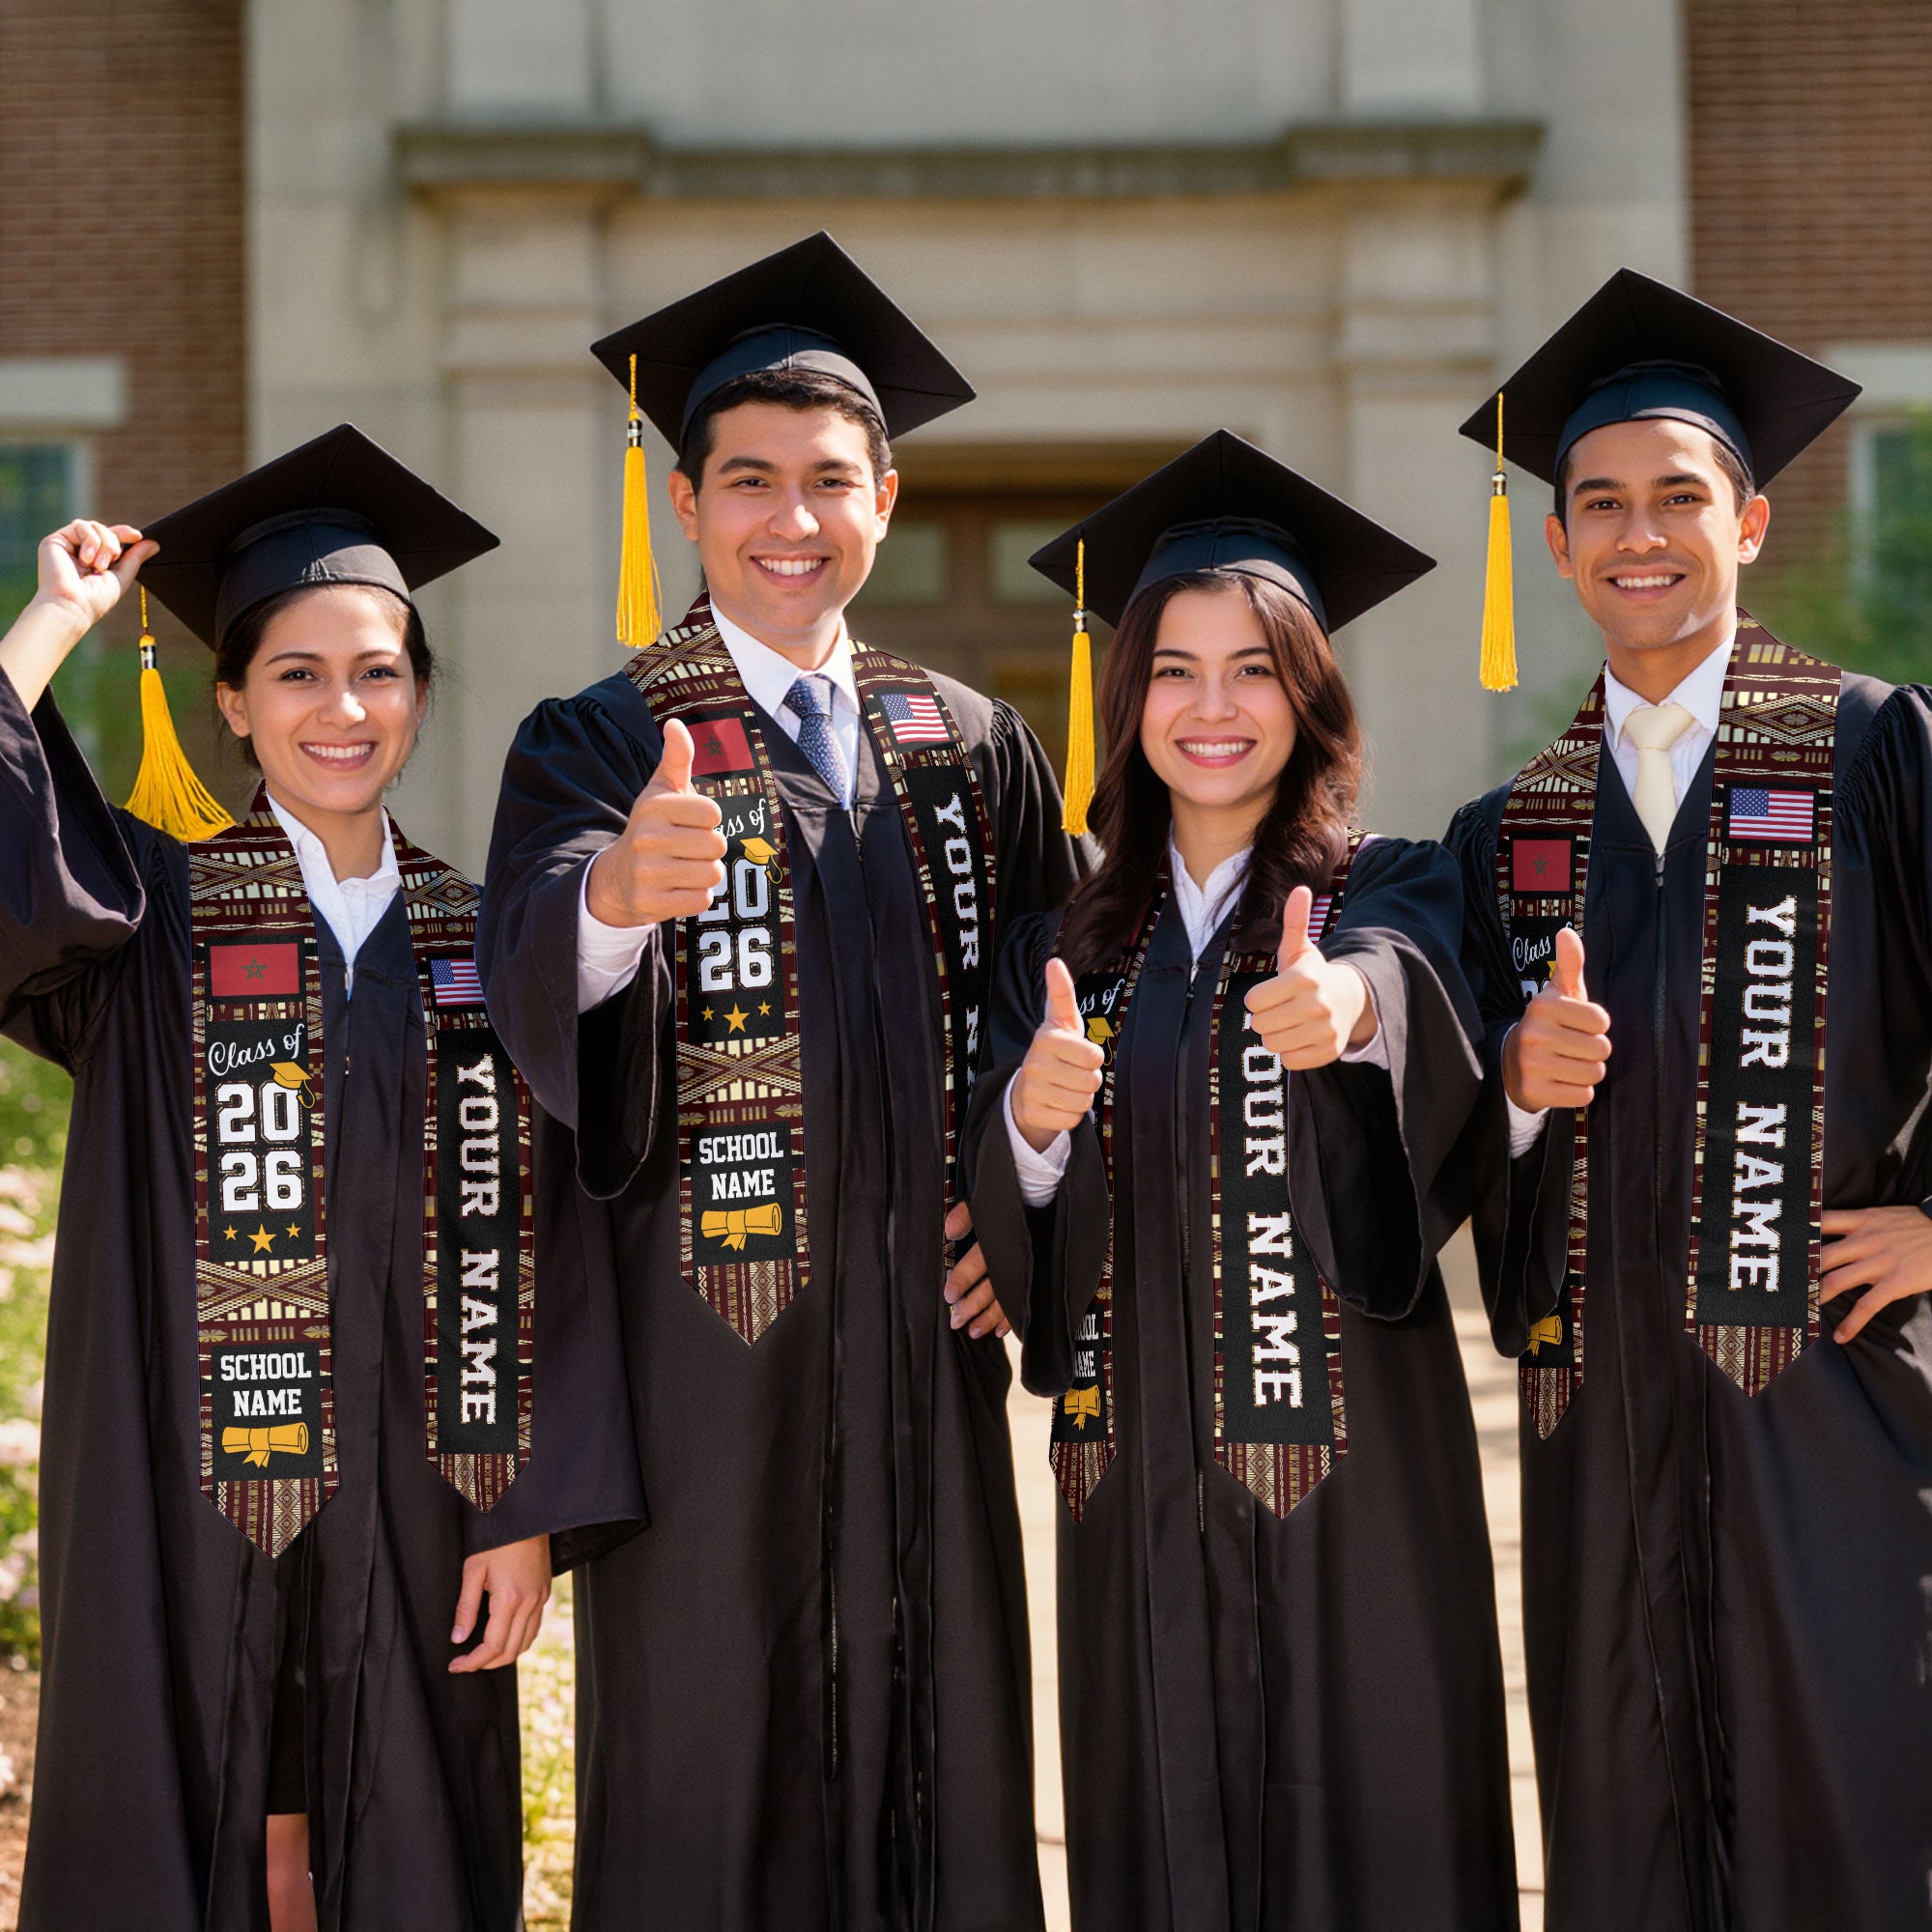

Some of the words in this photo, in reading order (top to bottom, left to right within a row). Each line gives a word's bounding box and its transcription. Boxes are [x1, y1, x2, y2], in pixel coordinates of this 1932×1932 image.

[749, 798, 766, 835] of
[933, 792, 980, 971] YOUR
[697, 925, 774, 993] 26
[1513, 936, 1551, 972] Class
[1741, 895, 1797, 1068] YOUR
[1101, 978, 1125, 1015] of
[208, 1037, 276, 1076] Class
[283, 1023, 305, 1059] of
[214, 1080, 305, 1145] 20
[1242, 1011, 1288, 1177] OUR
[456, 1053, 500, 1218] YOUR
[698, 1131, 784, 1165] SCHOOL
[218, 1148, 305, 1213] 26
[711, 1169, 776, 1201] NAME
[1728, 1101, 1787, 1293] NAME
[460, 1248, 500, 1425] NAME
[1246, 1211, 1304, 1408] NAME
[220, 1352, 312, 1381] SCHOOL
[233, 1388, 302, 1417] NAME
